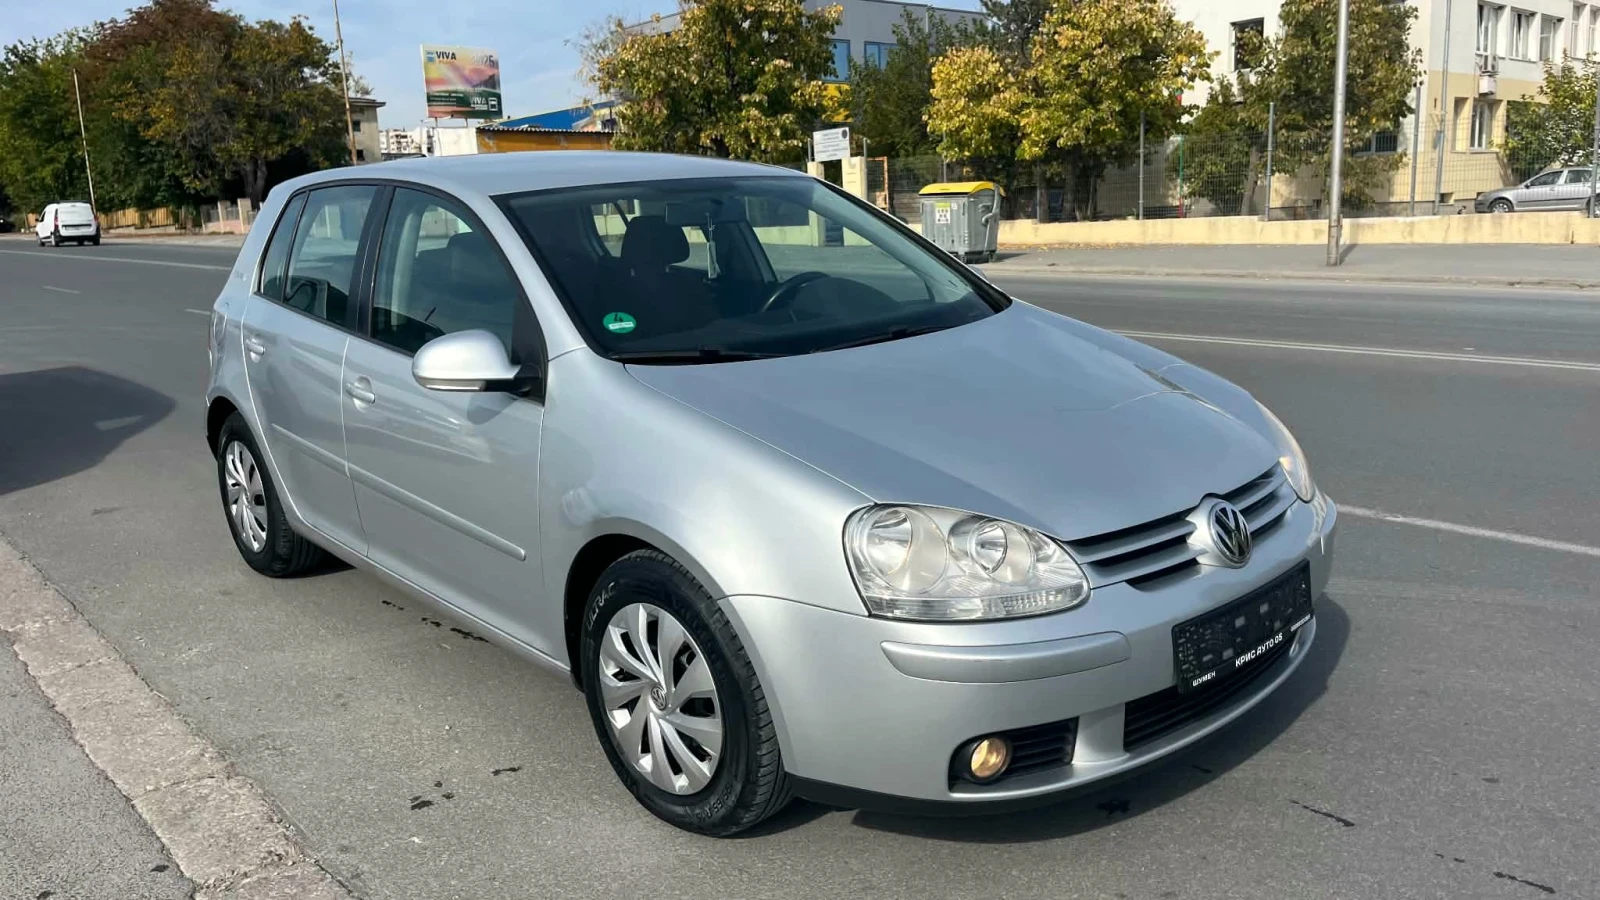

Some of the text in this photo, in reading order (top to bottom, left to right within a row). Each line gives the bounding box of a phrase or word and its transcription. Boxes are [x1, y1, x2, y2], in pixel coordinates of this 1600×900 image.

[435, 51, 457, 61] VIVA
[470, 96, 487, 105] VIVA
[1235, 632, 1283, 668] КРИС АУТО 05
[1192, 670, 1216, 687] ШУМЕН
